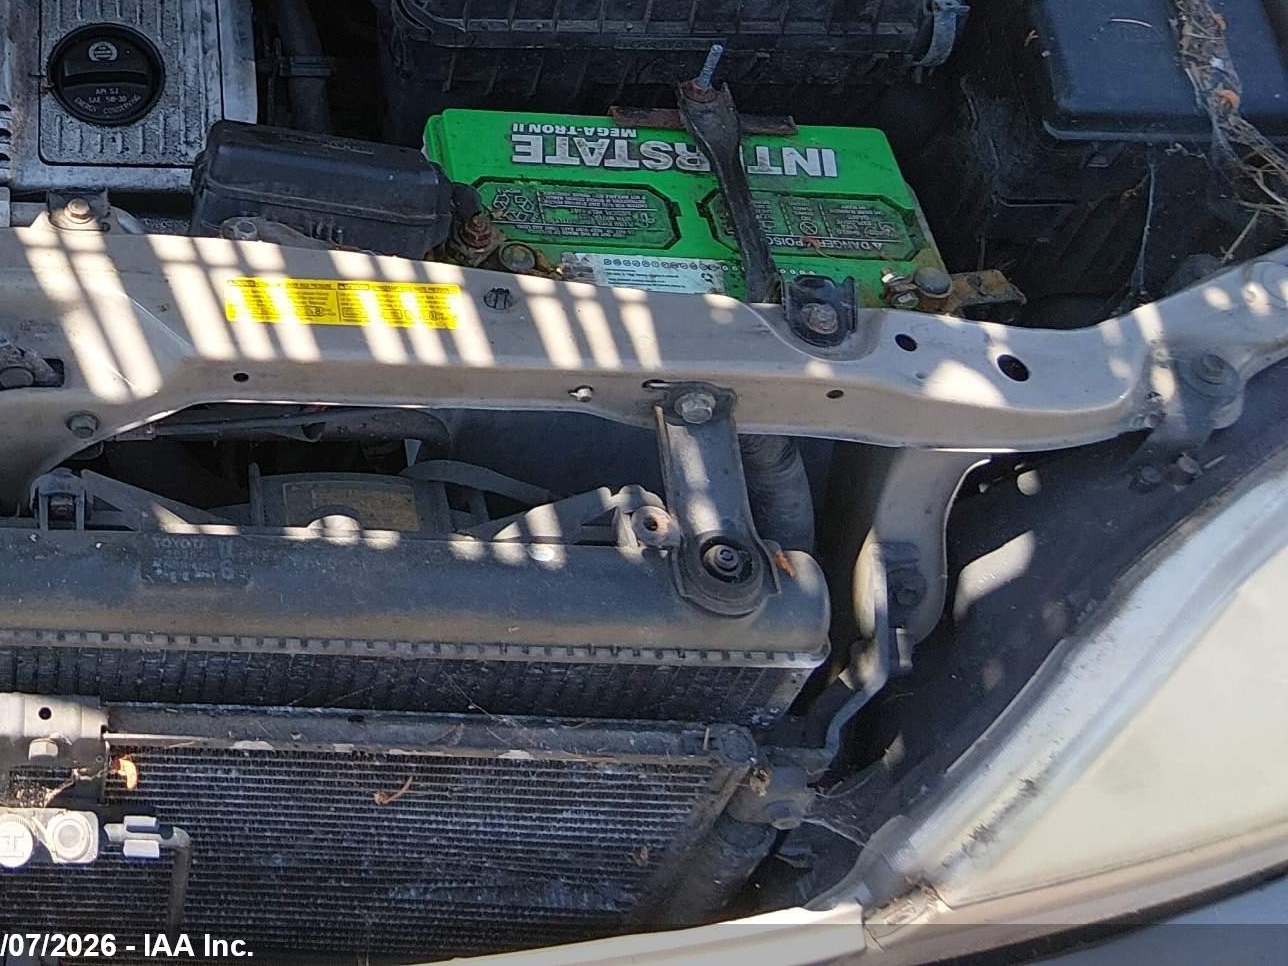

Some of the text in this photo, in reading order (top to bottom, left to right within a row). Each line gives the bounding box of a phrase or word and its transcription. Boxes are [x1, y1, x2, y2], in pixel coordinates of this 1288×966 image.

[511, 122, 639, 139] MEGA-TRON II
[511, 133, 838, 178] INTRSTATE
[765, 237, 804, 247] POISO
